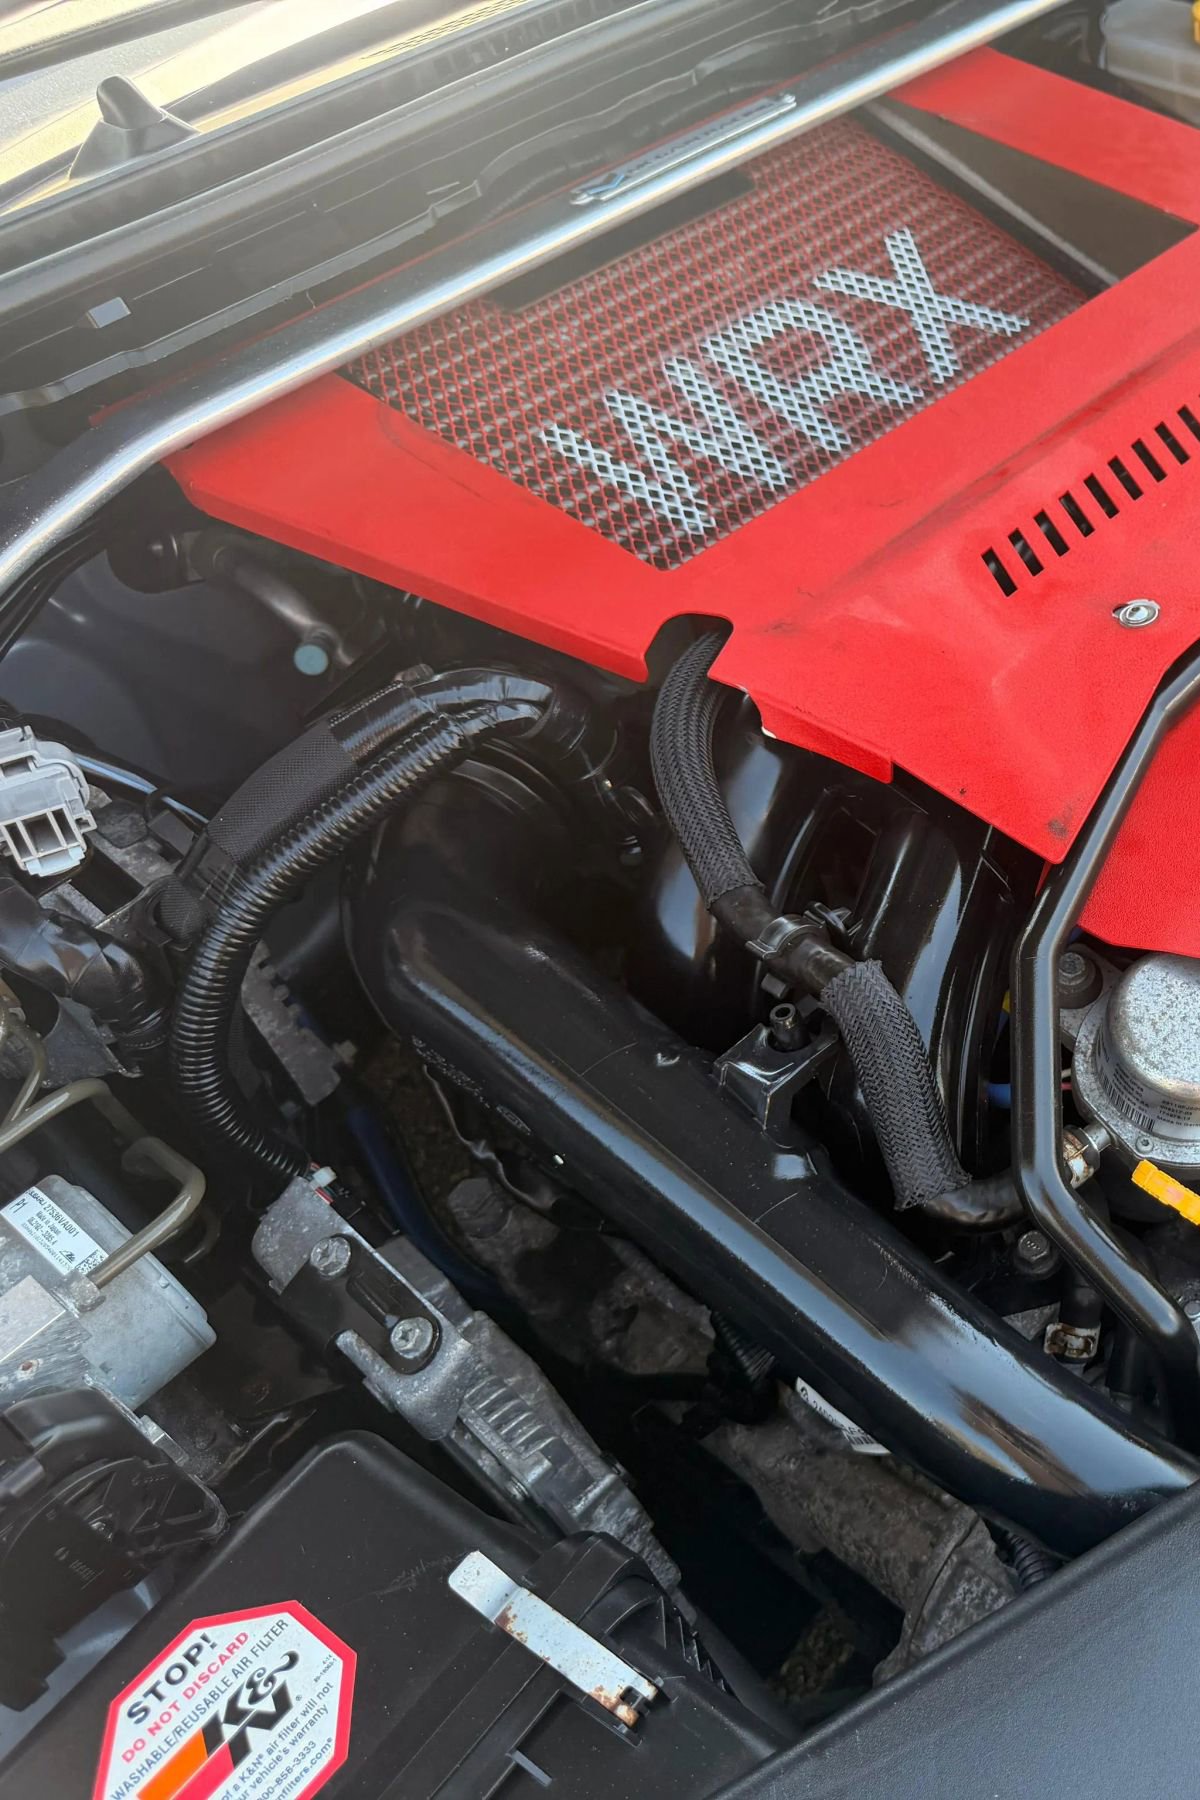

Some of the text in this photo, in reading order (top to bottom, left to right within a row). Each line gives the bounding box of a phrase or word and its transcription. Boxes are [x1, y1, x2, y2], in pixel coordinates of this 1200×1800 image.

[541, 227, 1030, 535] WRX
[111, 1619, 289, 1800] WASHABLE/REUSABLE AIR FILTER
[121, 1632, 249, 1763] DO NOT DISCARD
[127, 1632, 218, 1725] STOP!
[202, 1650, 299, 1769] K&N
[233, 1783, 240, 1791] a
[266, 1740, 280, 1756] air
[279, 1718, 301, 1741] filter
[300, 1699, 317, 1718] will
[317, 1682, 334, 1700] not
[250, 1747, 290, 1789] vehicle's
[289, 1704, 329, 1746] warranty
